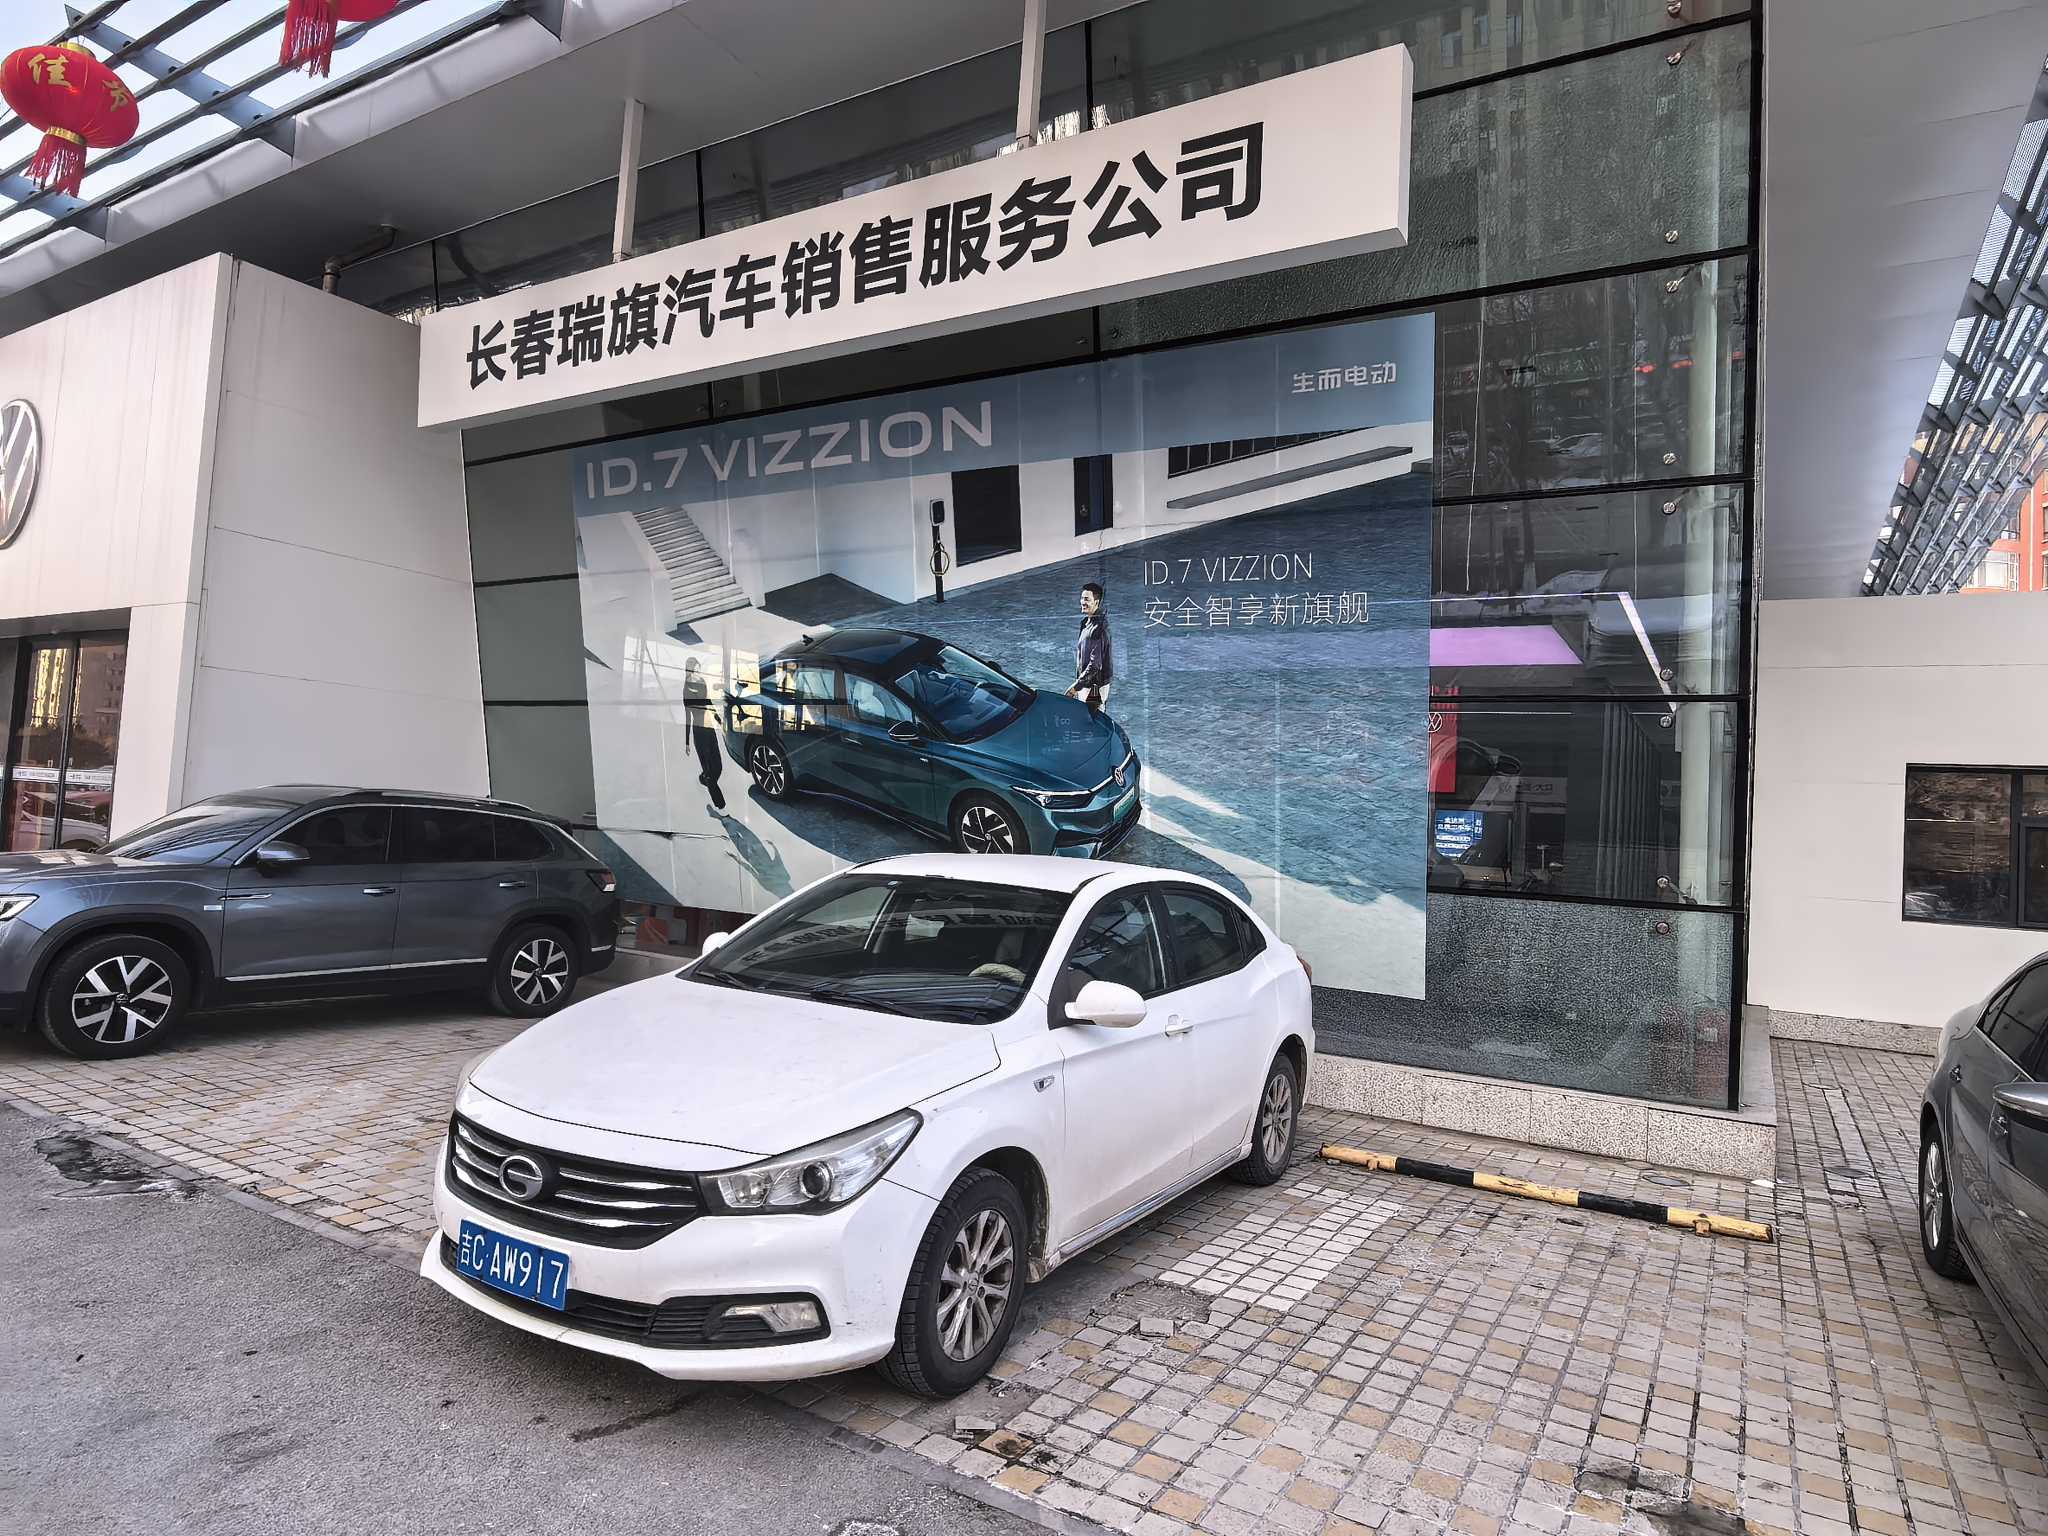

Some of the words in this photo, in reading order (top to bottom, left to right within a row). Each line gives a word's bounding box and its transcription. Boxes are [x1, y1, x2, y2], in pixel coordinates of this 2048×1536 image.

[466, 122, 1265, 390] 长春瑞旗汽车销售服务公司
[1291, 360, 1397, 394] 生而电动
[585, 447, 689, 500] ID.7
[700, 401, 992, 482] VIZZION
[1143, 558, 1192, 586] ID.7
[1202, 552, 1313, 583] VIZZION
[1143, 591, 1369, 629] 安全智享新旗舰
